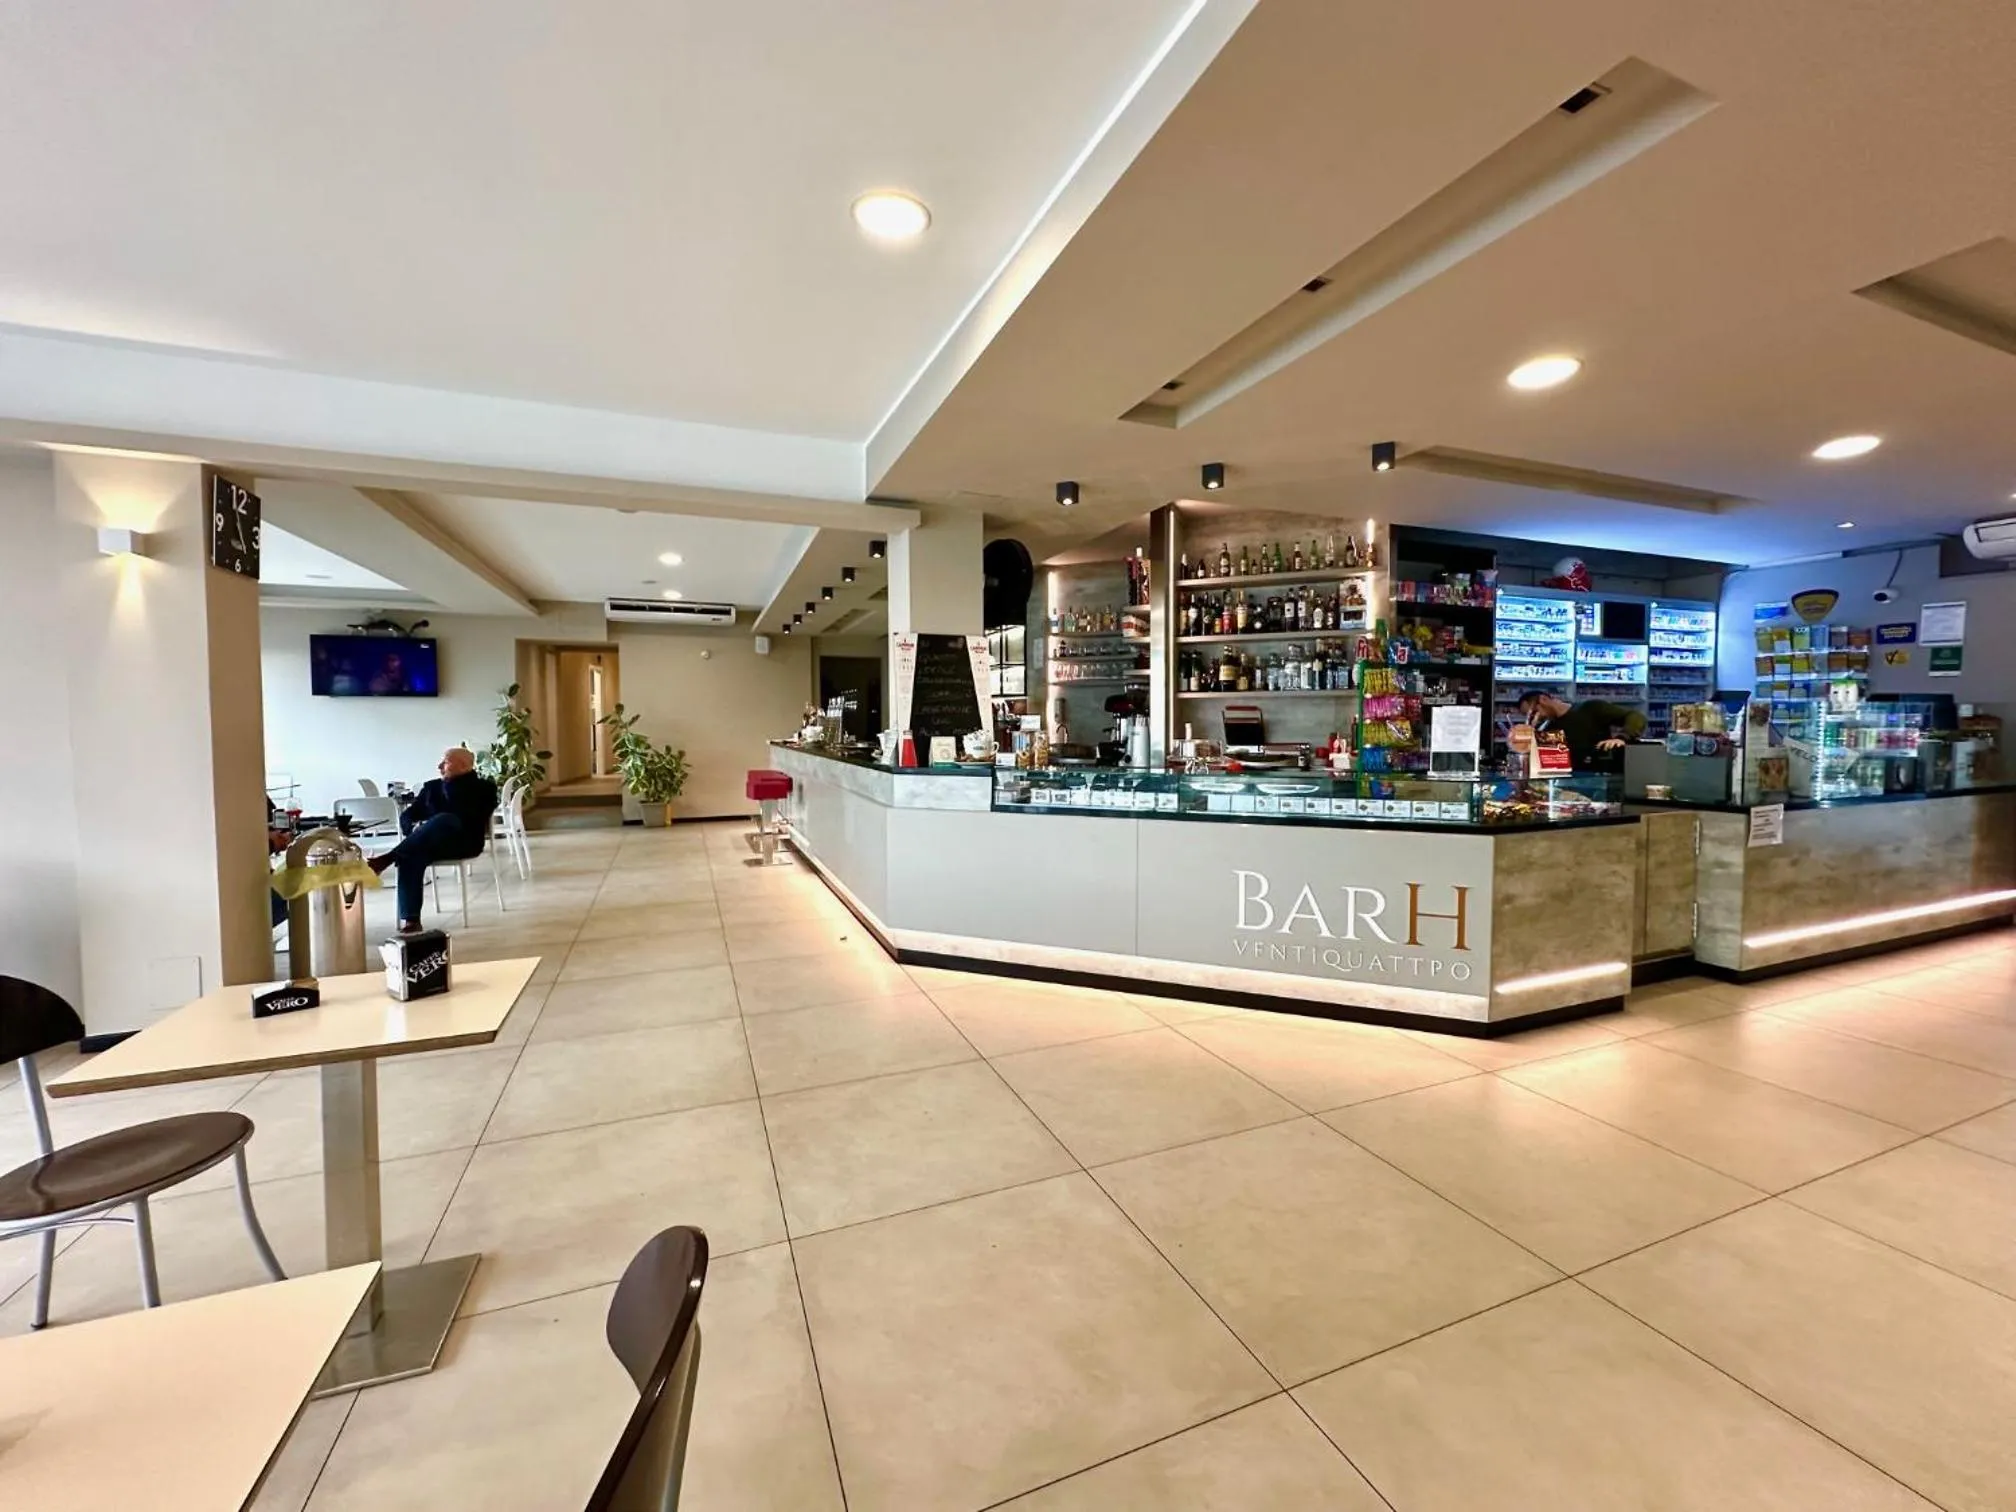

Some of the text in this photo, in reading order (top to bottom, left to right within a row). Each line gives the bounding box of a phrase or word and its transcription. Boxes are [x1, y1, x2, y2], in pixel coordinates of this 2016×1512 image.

[230, 484, 248, 515] 12
[215, 513, 225, 532] 9
[252, 525, 261, 549] 3
[234, 558, 242, 573] 6
[265, 996, 309, 1012] VERO
